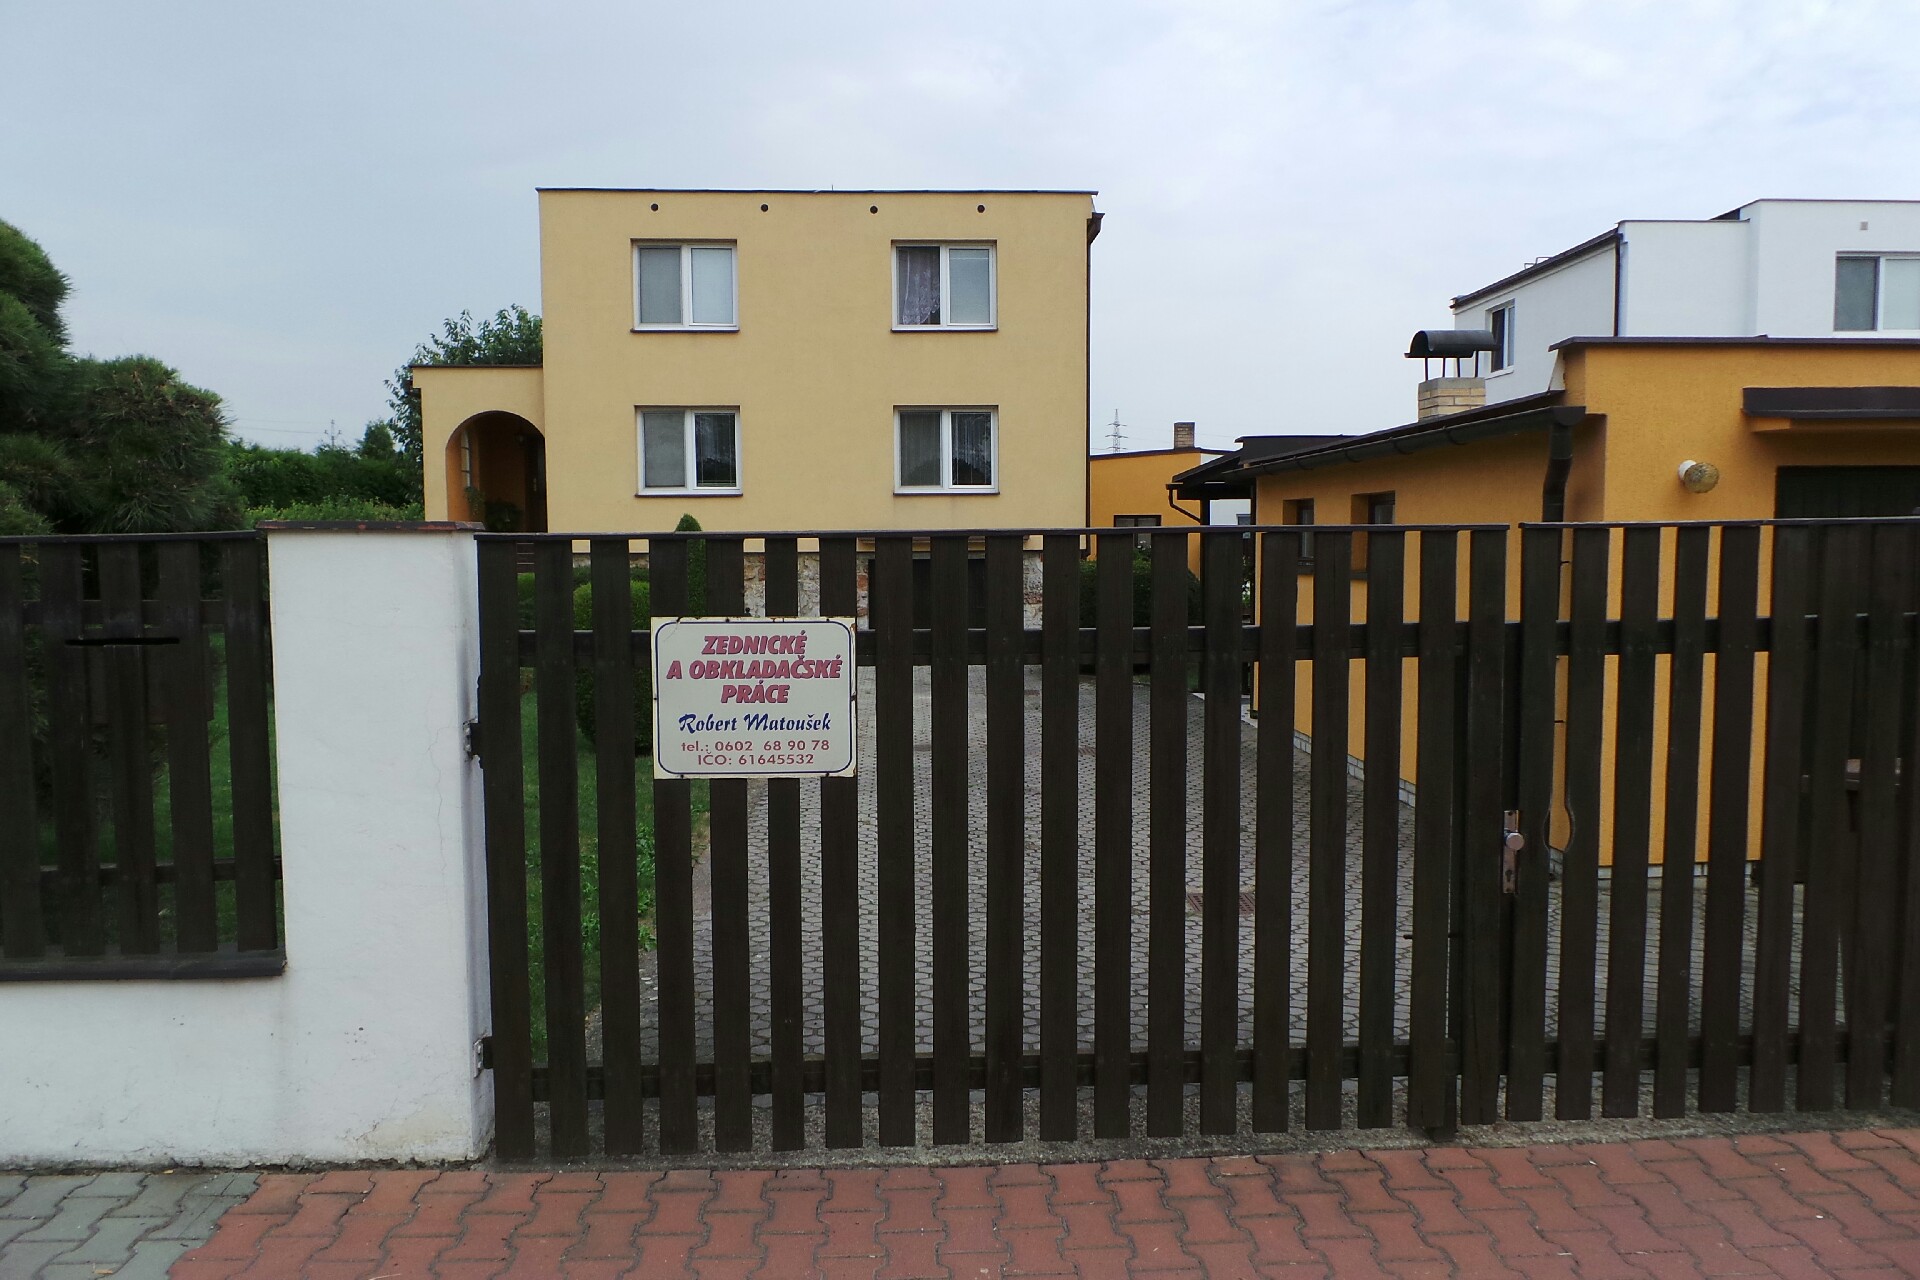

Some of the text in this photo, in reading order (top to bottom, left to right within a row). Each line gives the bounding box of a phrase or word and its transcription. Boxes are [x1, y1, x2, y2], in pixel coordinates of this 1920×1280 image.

[701, 630, 807, 654] ZEDNICKÉ
[666, 654, 842, 679] A OBKLADAČSKÉ
[720, 680, 790, 703] PRÁCE
[679, 713, 831, 733] Robert Matoušek
[681, 740, 830, 752] tel.: 0602 68 90 78
[698, 751, 814, 765] IČO: 61645532
